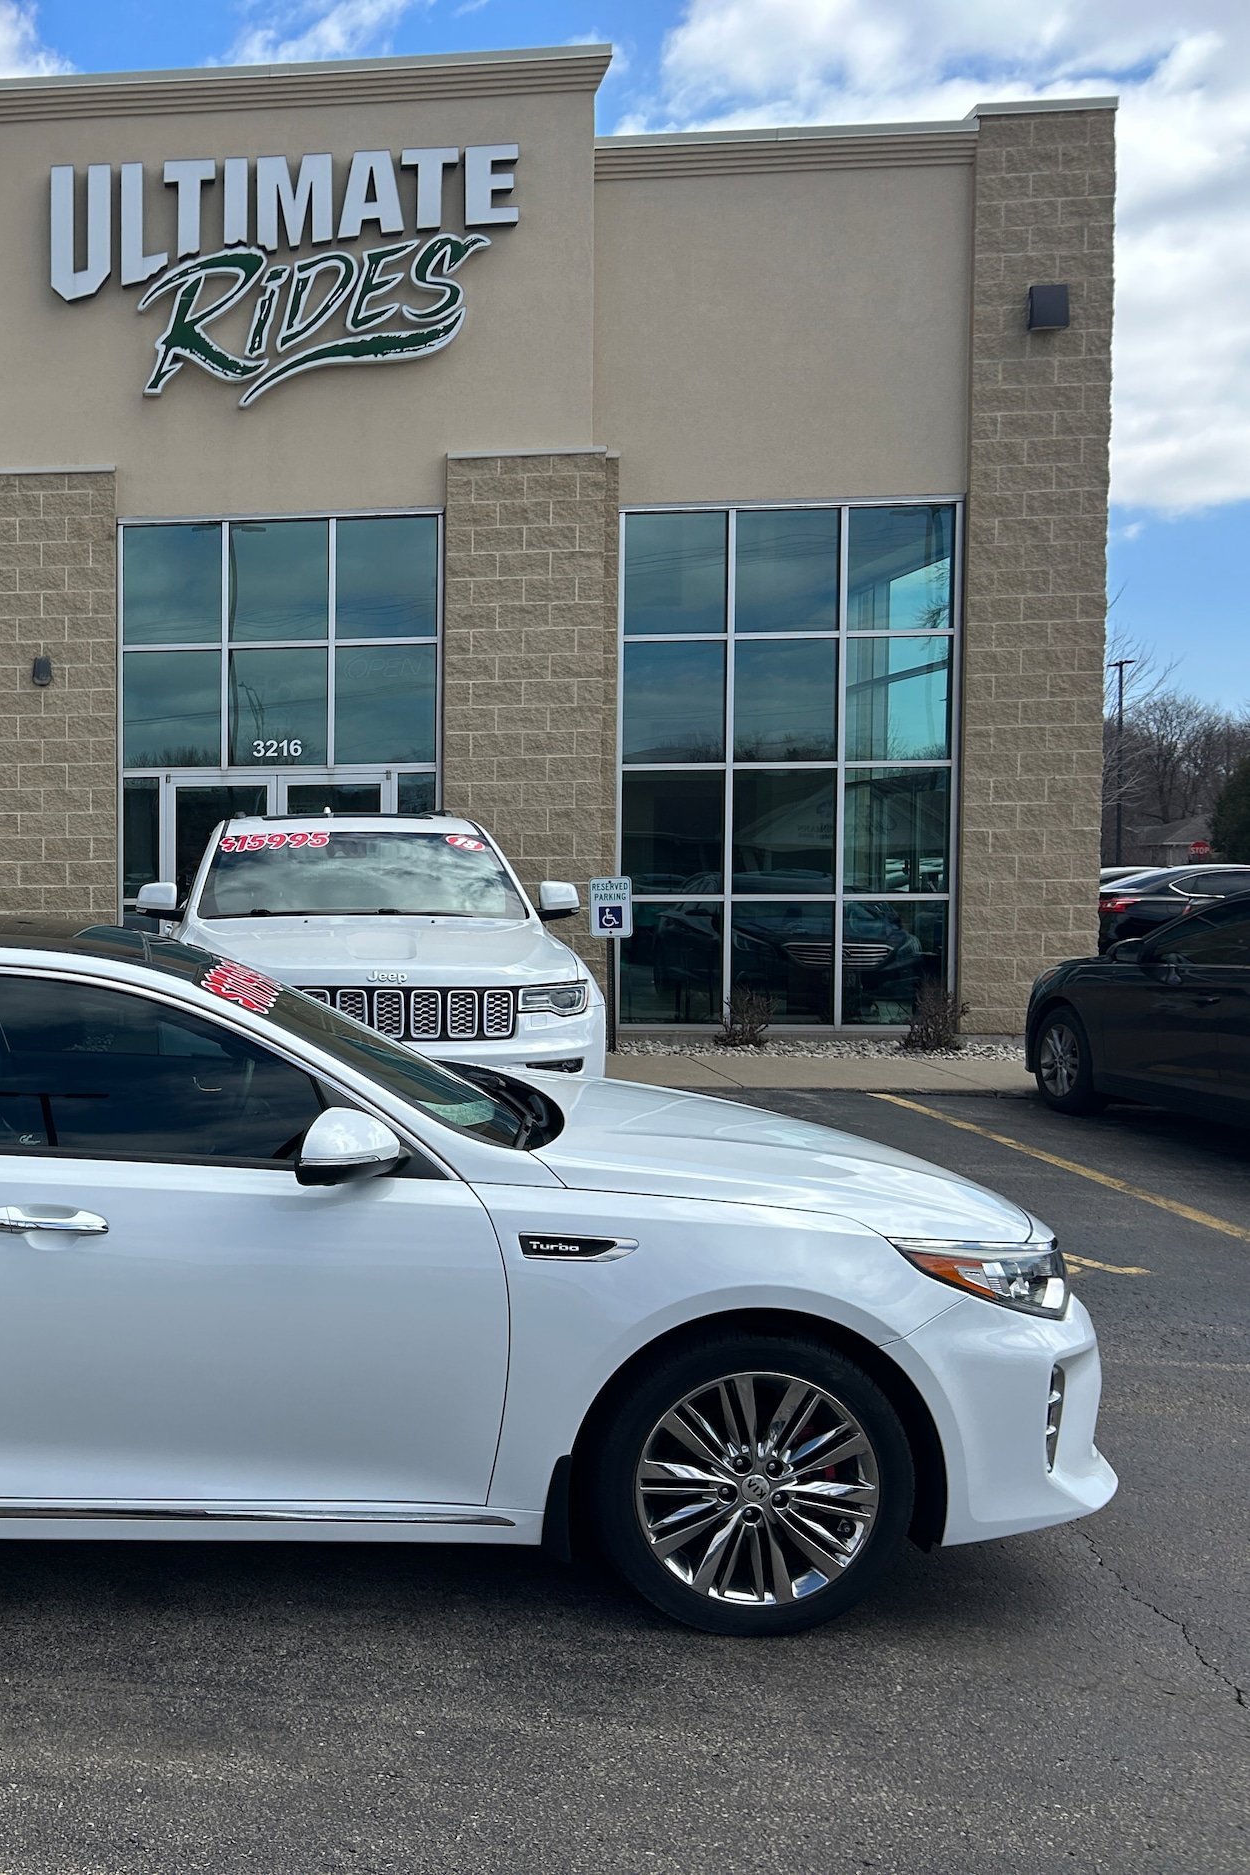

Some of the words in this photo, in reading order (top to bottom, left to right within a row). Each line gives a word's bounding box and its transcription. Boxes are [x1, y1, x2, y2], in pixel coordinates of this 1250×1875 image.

[50, 143, 520, 302] ULTIMATE
[253, 739, 303, 757] 3216
[219, 832, 329, 852] $15995
[592, 882, 629, 891] RESERVED
[594, 893, 627, 901] PARKING
[366, 970, 408, 984] Jeep
[528, 1241, 580, 1252] Turbo
[747, 1479, 767, 1500] KIA
